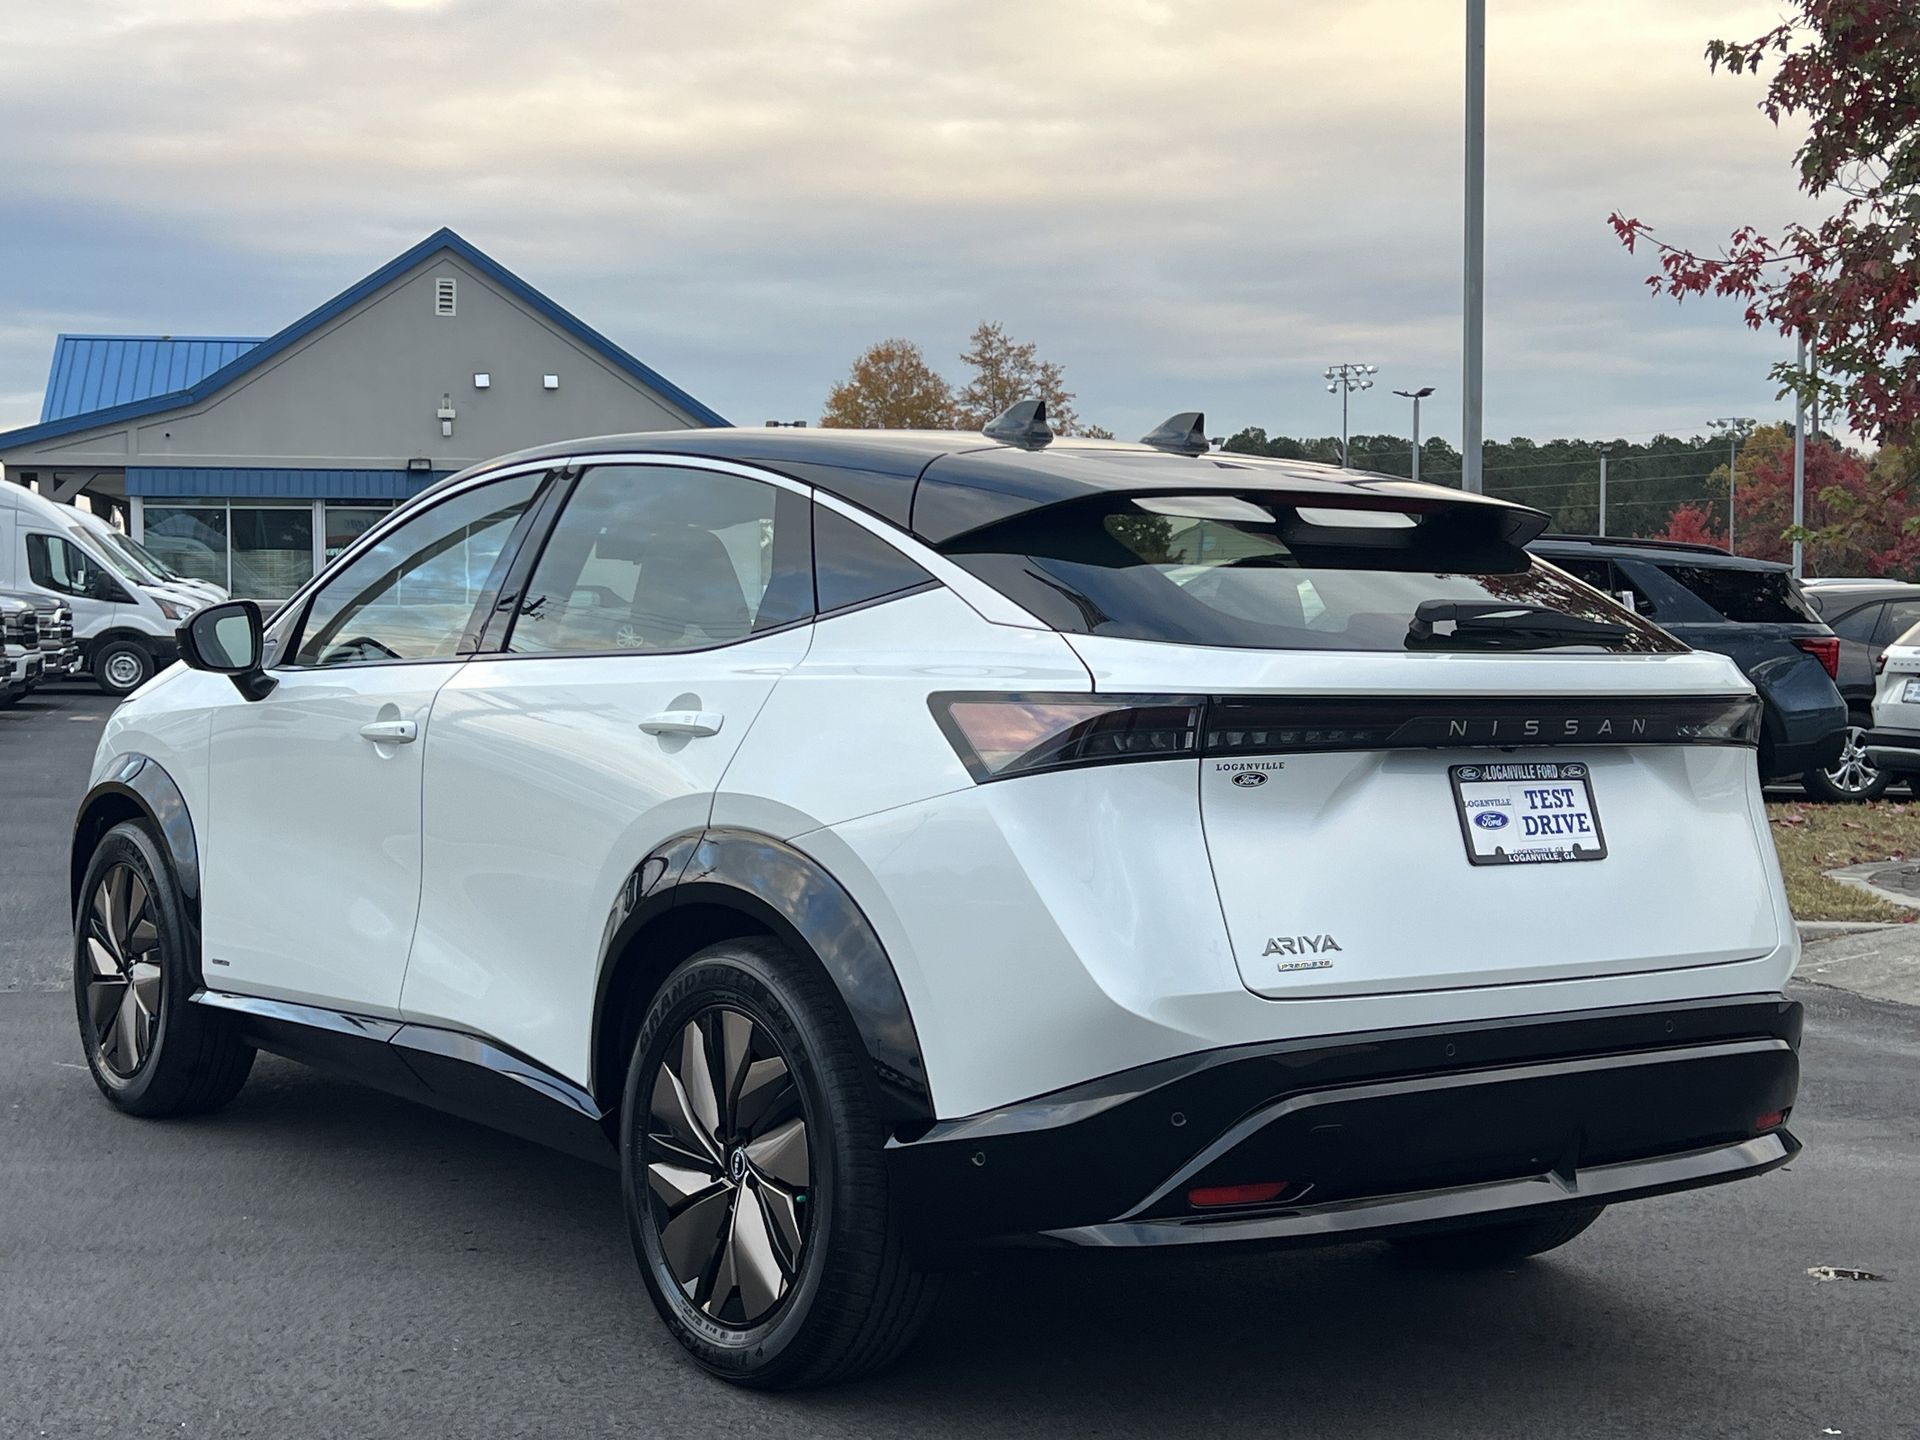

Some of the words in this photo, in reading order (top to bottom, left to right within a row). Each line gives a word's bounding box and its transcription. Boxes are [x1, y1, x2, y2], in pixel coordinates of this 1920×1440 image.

[1449, 718, 1647, 737] NISSAN
[1215, 762, 1285, 771] LOGANVILLE
[1485, 765, 1536, 780] LOGANVILLE
[1537, 764, 1559, 779] FORD
[1524, 788, 1575, 810] TEST
[1522, 813, 1591, 836] DRIVE
[1508, 852, 1563, 863] LOGANVILLE,
[1563, 851, 1577, 860] GA
[1262, 934, 1343, 957] ARIYA
